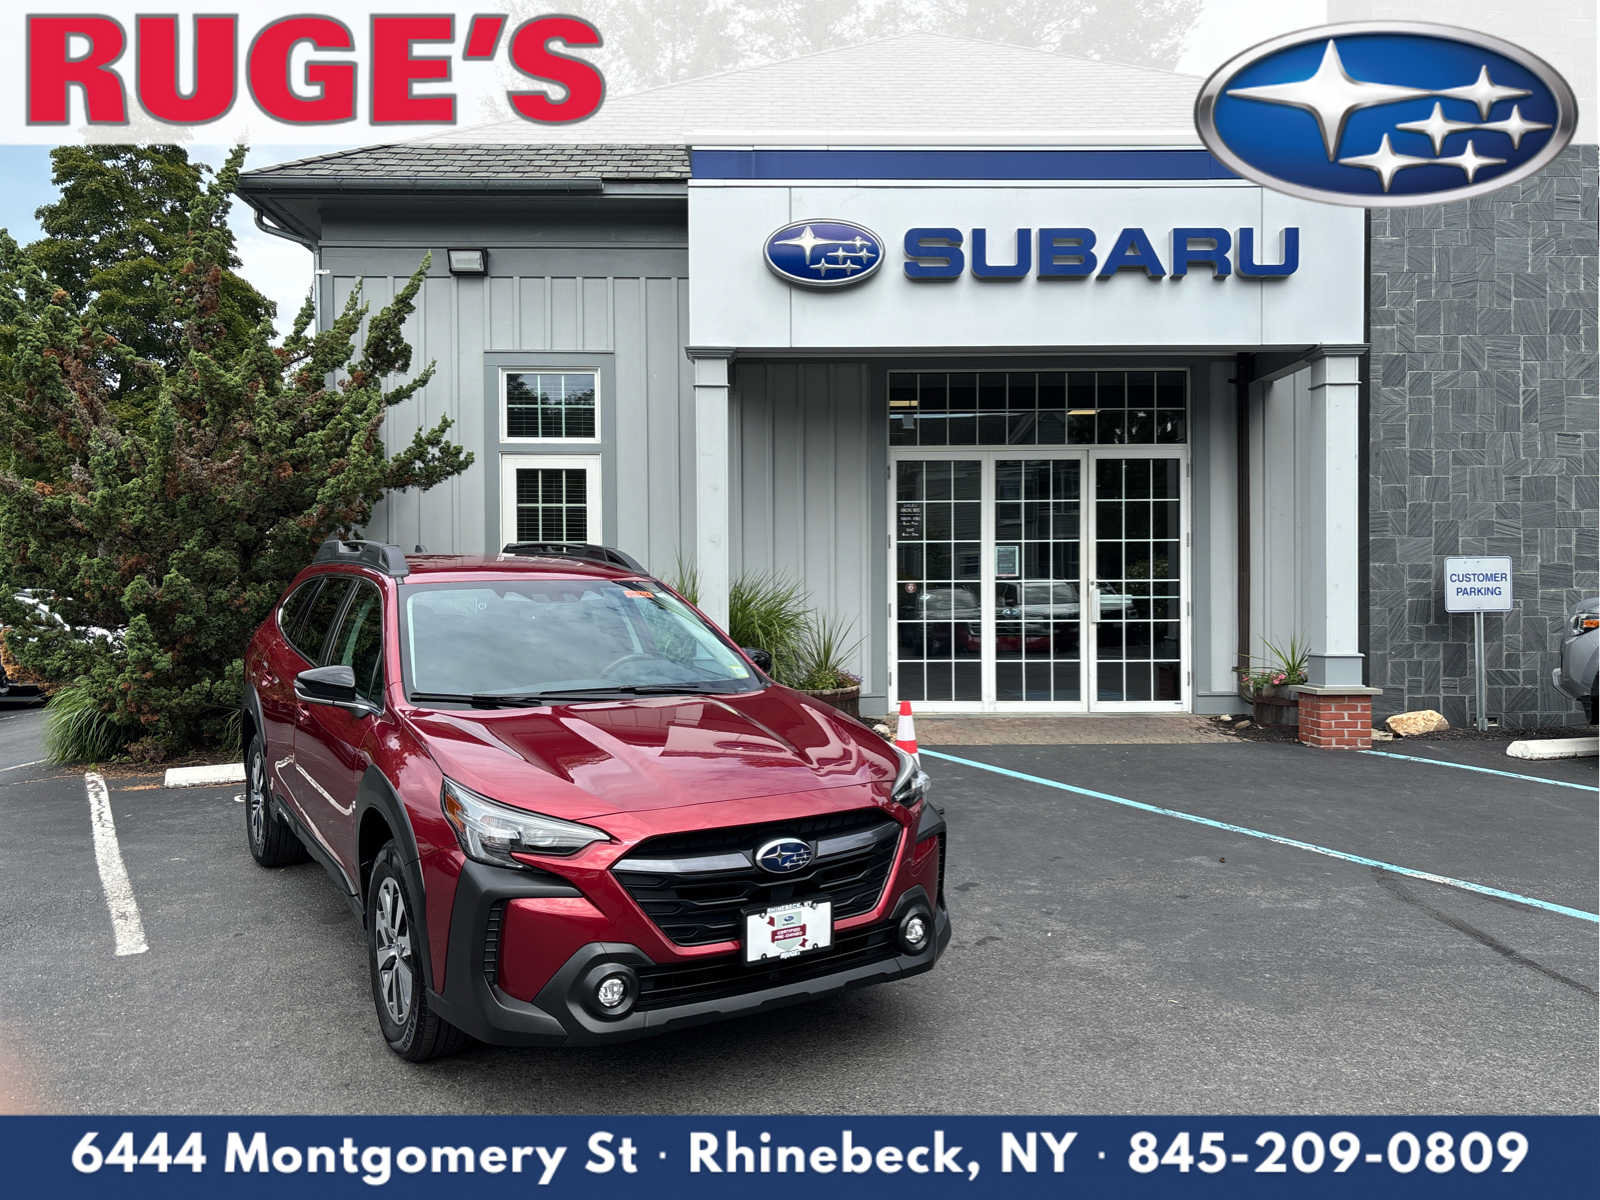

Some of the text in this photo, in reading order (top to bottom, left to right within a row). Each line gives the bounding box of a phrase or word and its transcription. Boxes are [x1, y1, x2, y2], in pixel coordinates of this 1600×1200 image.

[903, 227, 1300, 279] SUBARU
[1449, 573, 1508, 583] CUSTOMER
[1456, 587, 1502, 596] PARKING
